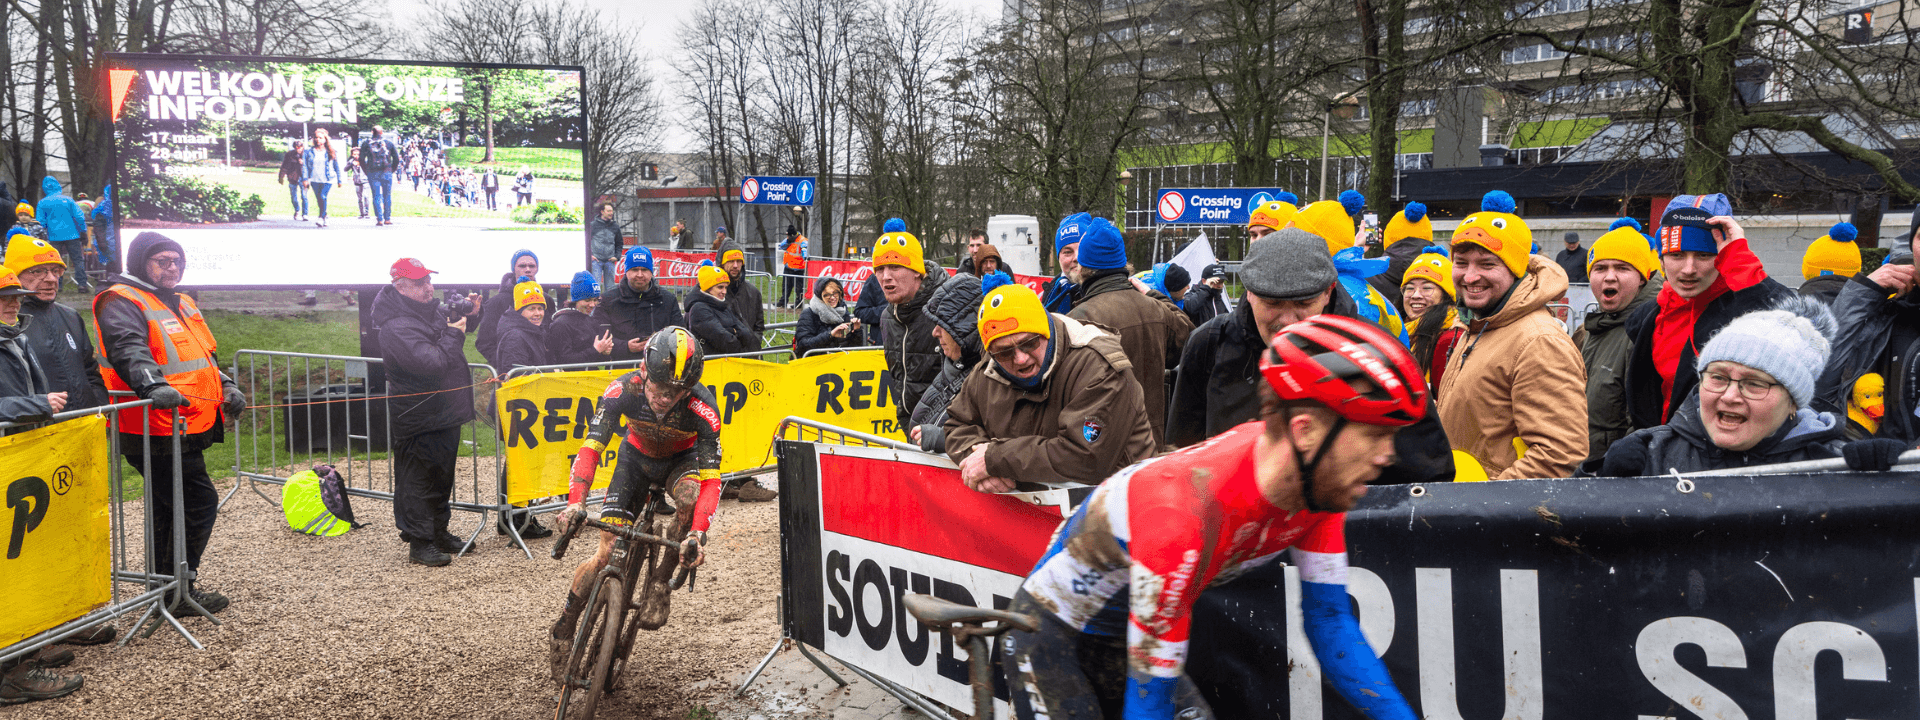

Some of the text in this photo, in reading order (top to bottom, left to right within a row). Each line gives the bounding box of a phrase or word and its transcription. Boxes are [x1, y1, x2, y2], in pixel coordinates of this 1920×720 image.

[144, 69, 465, 102] WELKOM OP ONZE
[147, 95, 358, 124] INFODAGEN
[149, 131, 218, 144] 17 maart
[150, 147, 208, 163] 28 april
[761, 181, 794, 193] Crossing
[766, 191, 787, 202] Point
[1190, 194, 1242, 210] Crossing
[1199, 207, 1231, 219] Point
[1061, 226, 1078, 236] VUB
[826, 549, 1015, 702] SOUD
